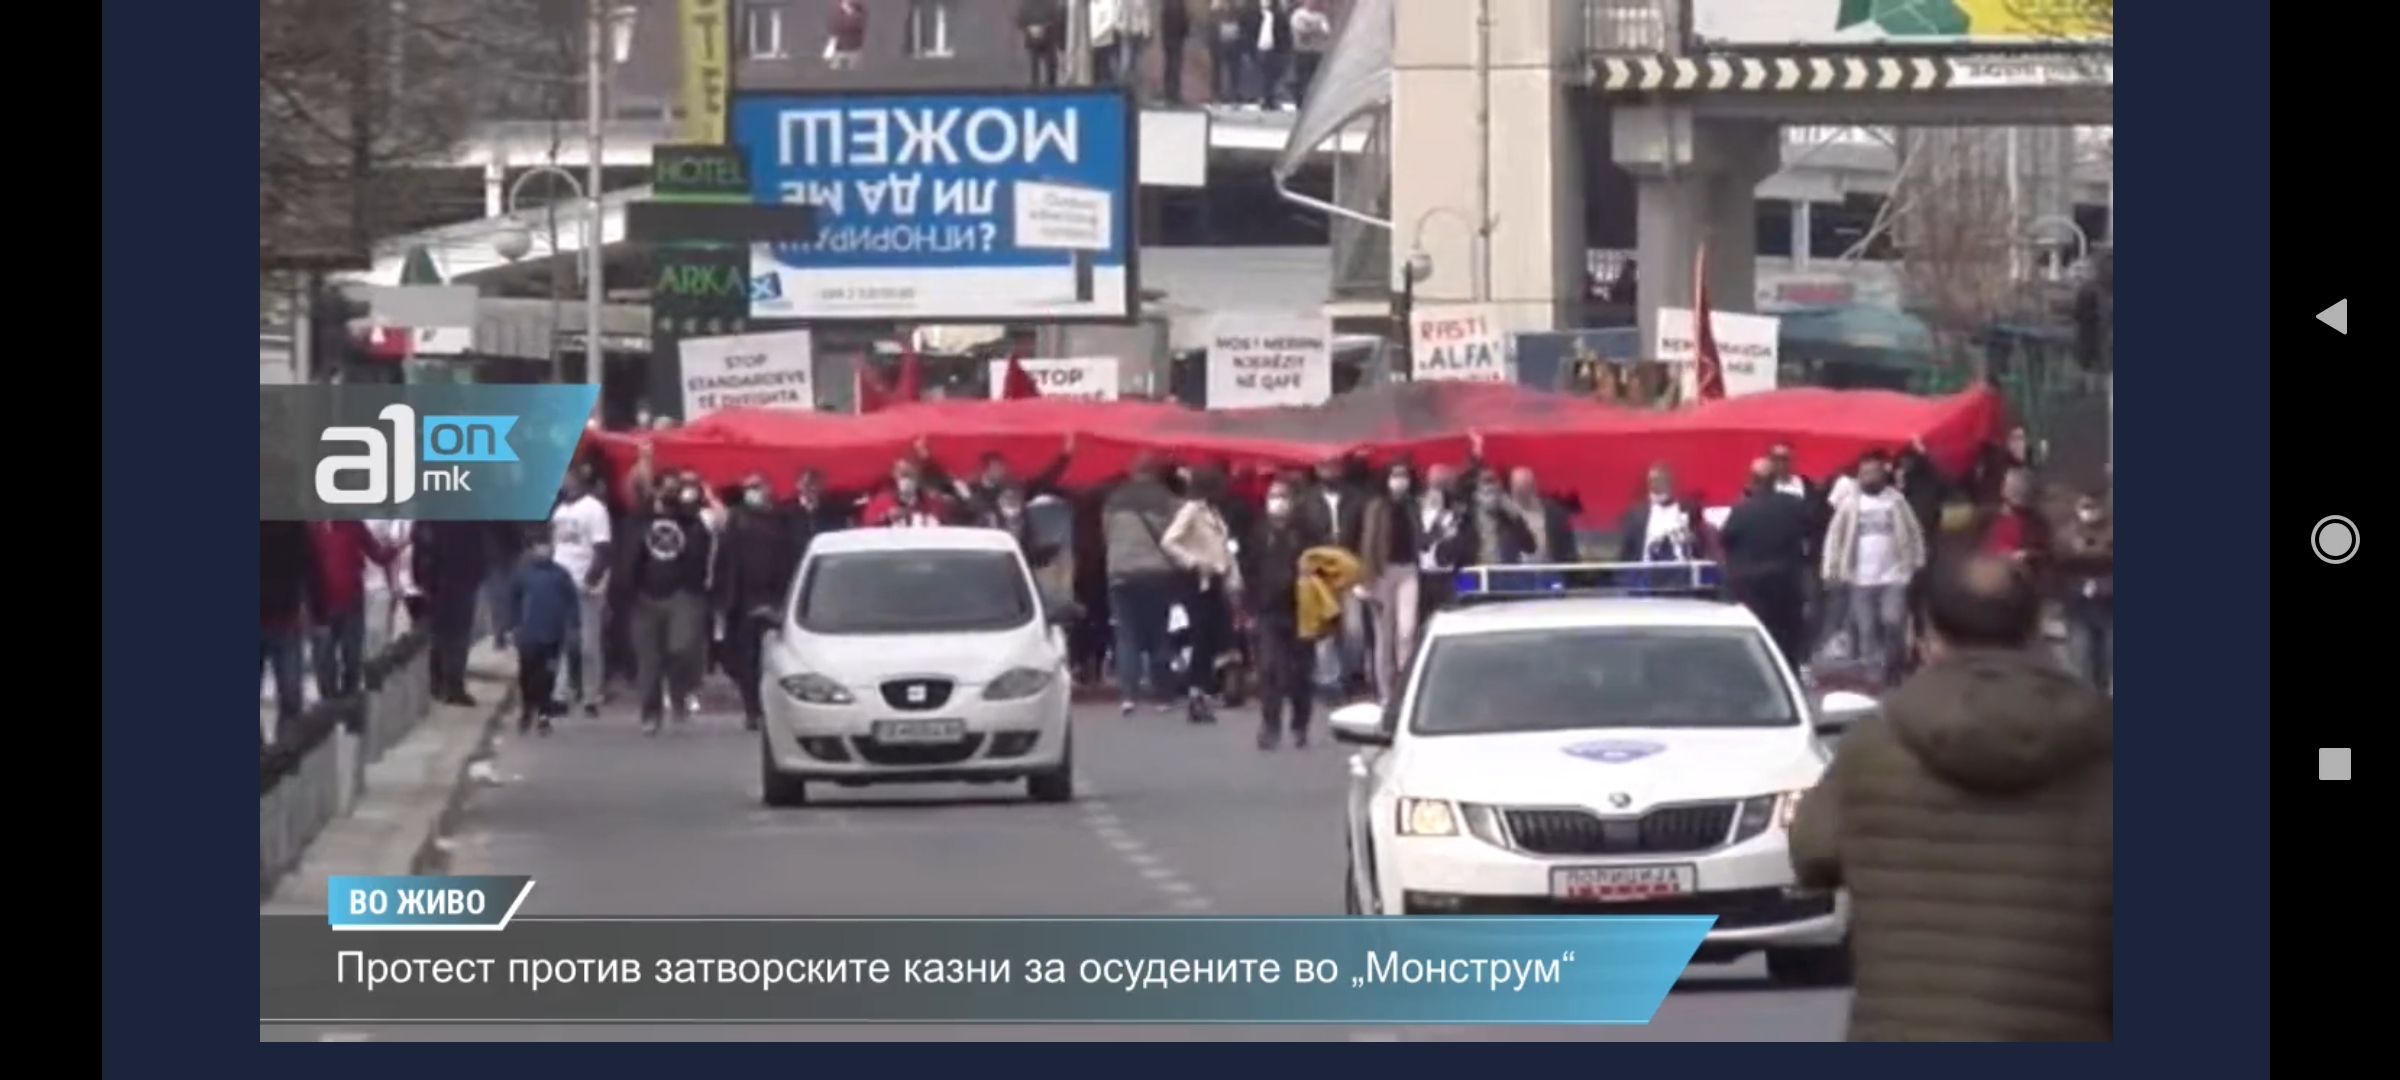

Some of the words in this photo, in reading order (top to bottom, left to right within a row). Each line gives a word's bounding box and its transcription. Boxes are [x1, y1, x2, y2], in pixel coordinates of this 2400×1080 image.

[778, 108, 1078, 166] МОЖЕШ
[656, 156, 746, 184] HOTEL
[858, 173, 924, 217] ДА
[935, 178, 998, 216] ЛИ
[656, 265, 746, 295] ARKA
[1420, 315, 1488, 342] RASTI
[724, 353, 768, 370] STOP
